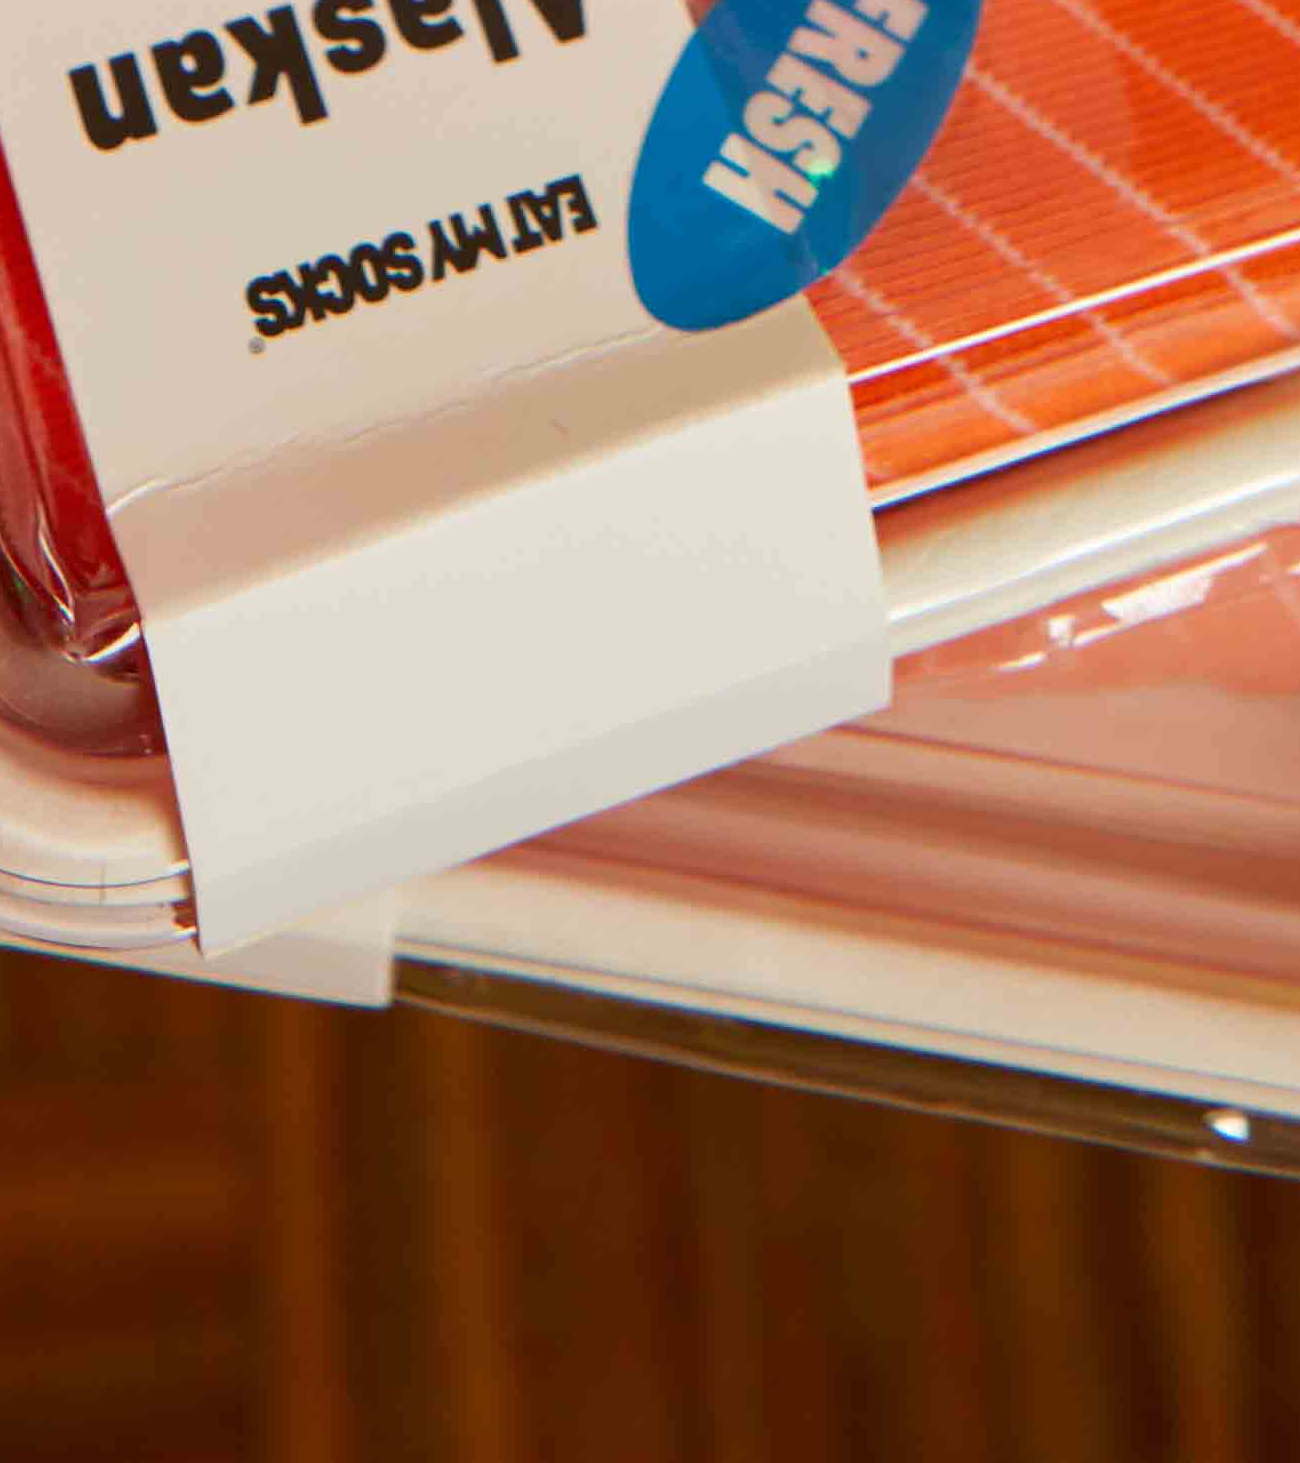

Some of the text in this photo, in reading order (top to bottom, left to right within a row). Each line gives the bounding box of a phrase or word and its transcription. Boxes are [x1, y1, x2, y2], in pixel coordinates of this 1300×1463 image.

[245, 173, 598, 337] EAT MY SOCKS
